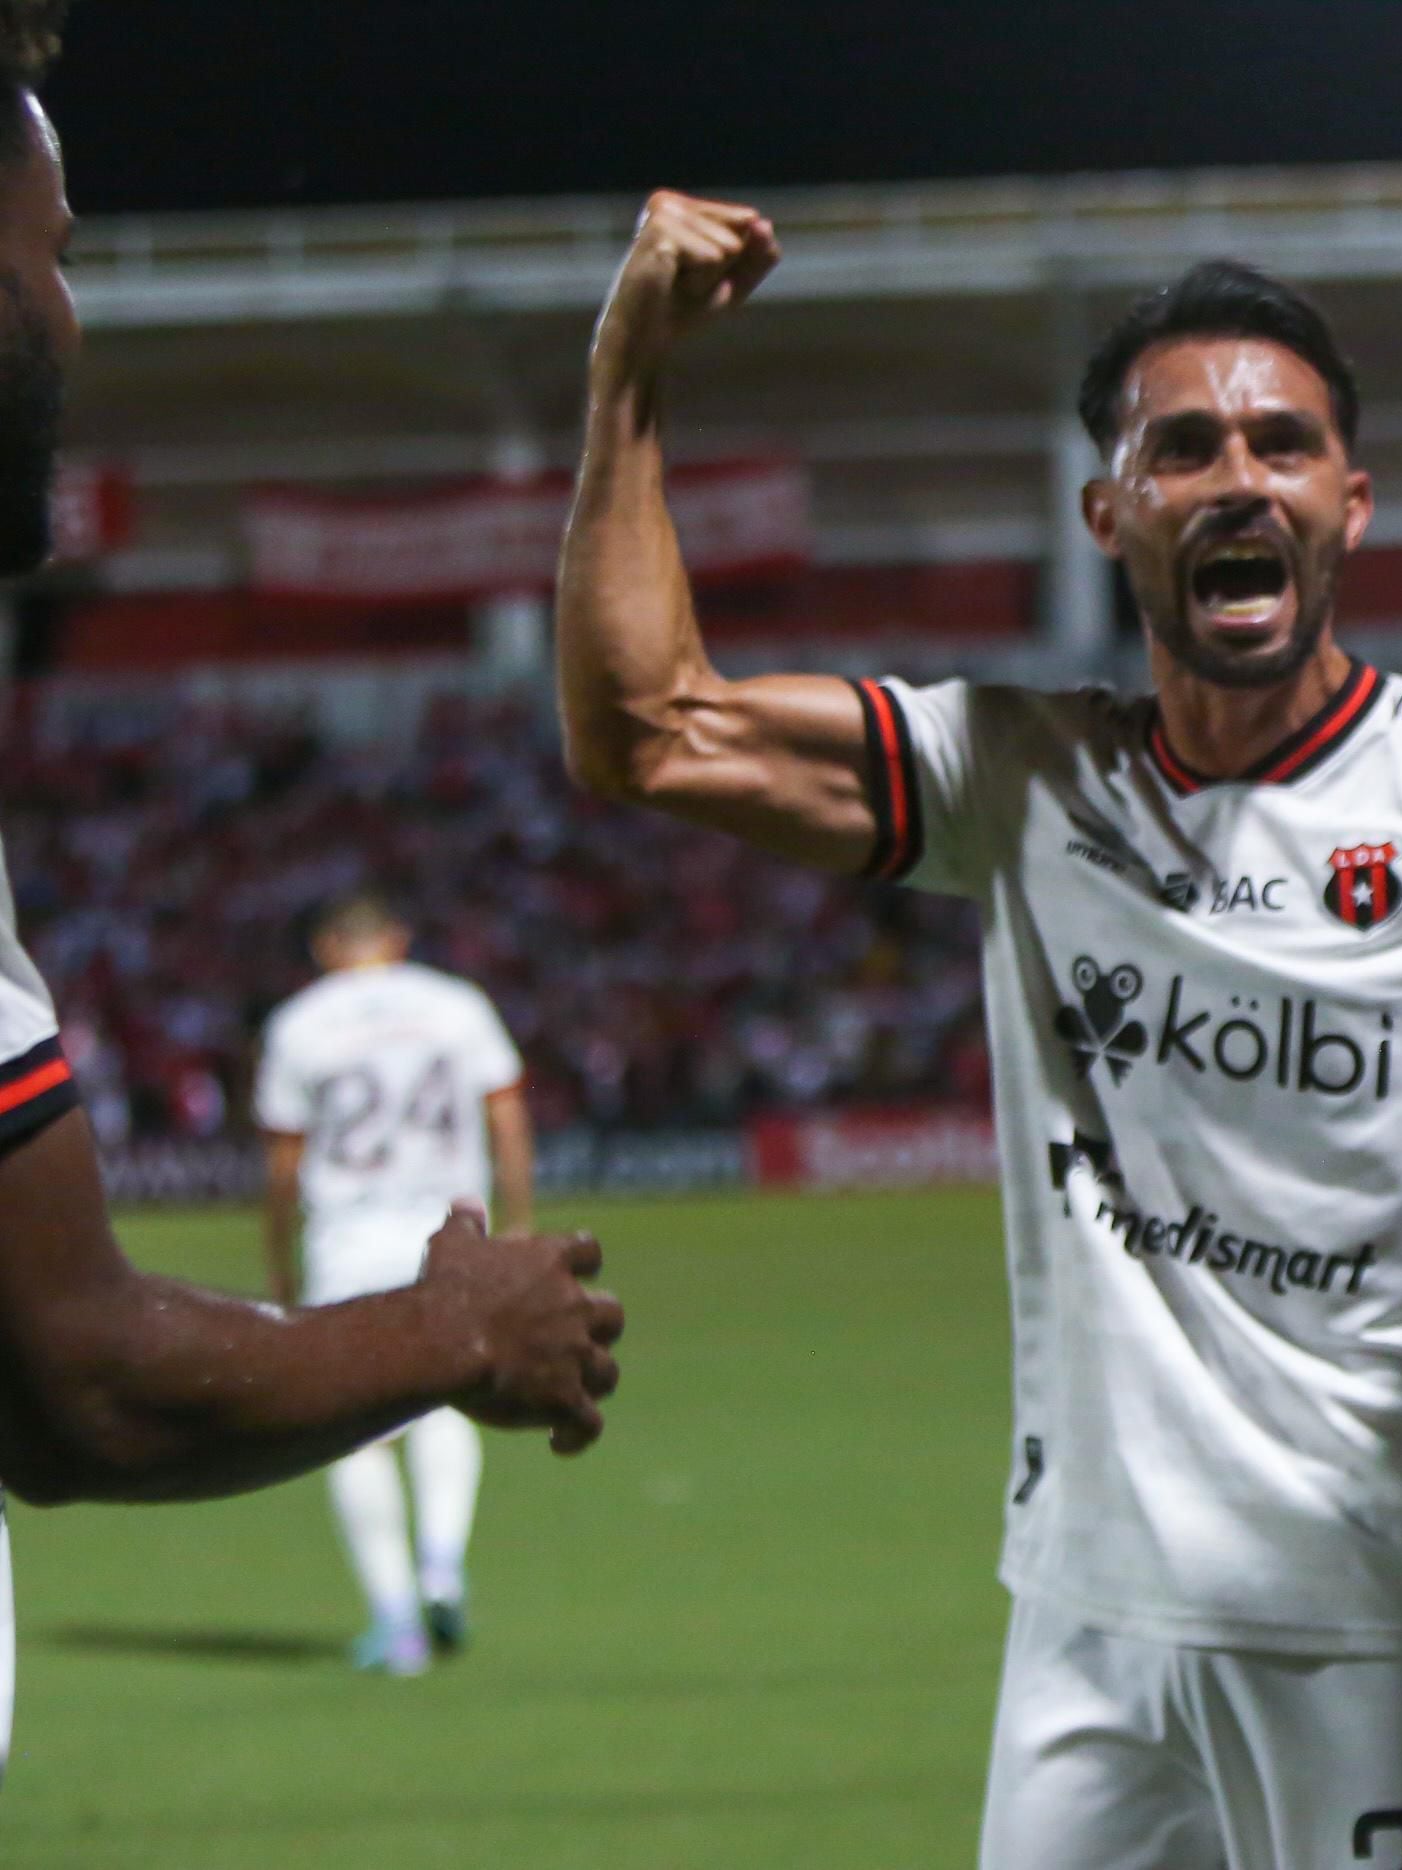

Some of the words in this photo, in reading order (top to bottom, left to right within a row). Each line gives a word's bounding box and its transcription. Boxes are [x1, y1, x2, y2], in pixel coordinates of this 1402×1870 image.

[1209, 875, 1289, 916] BAC
[1157, 974, 1393, 1100] kölbi
[302, 1053, 462, 1172] 24
[1096, 1204, 1376, 1297] medismart
